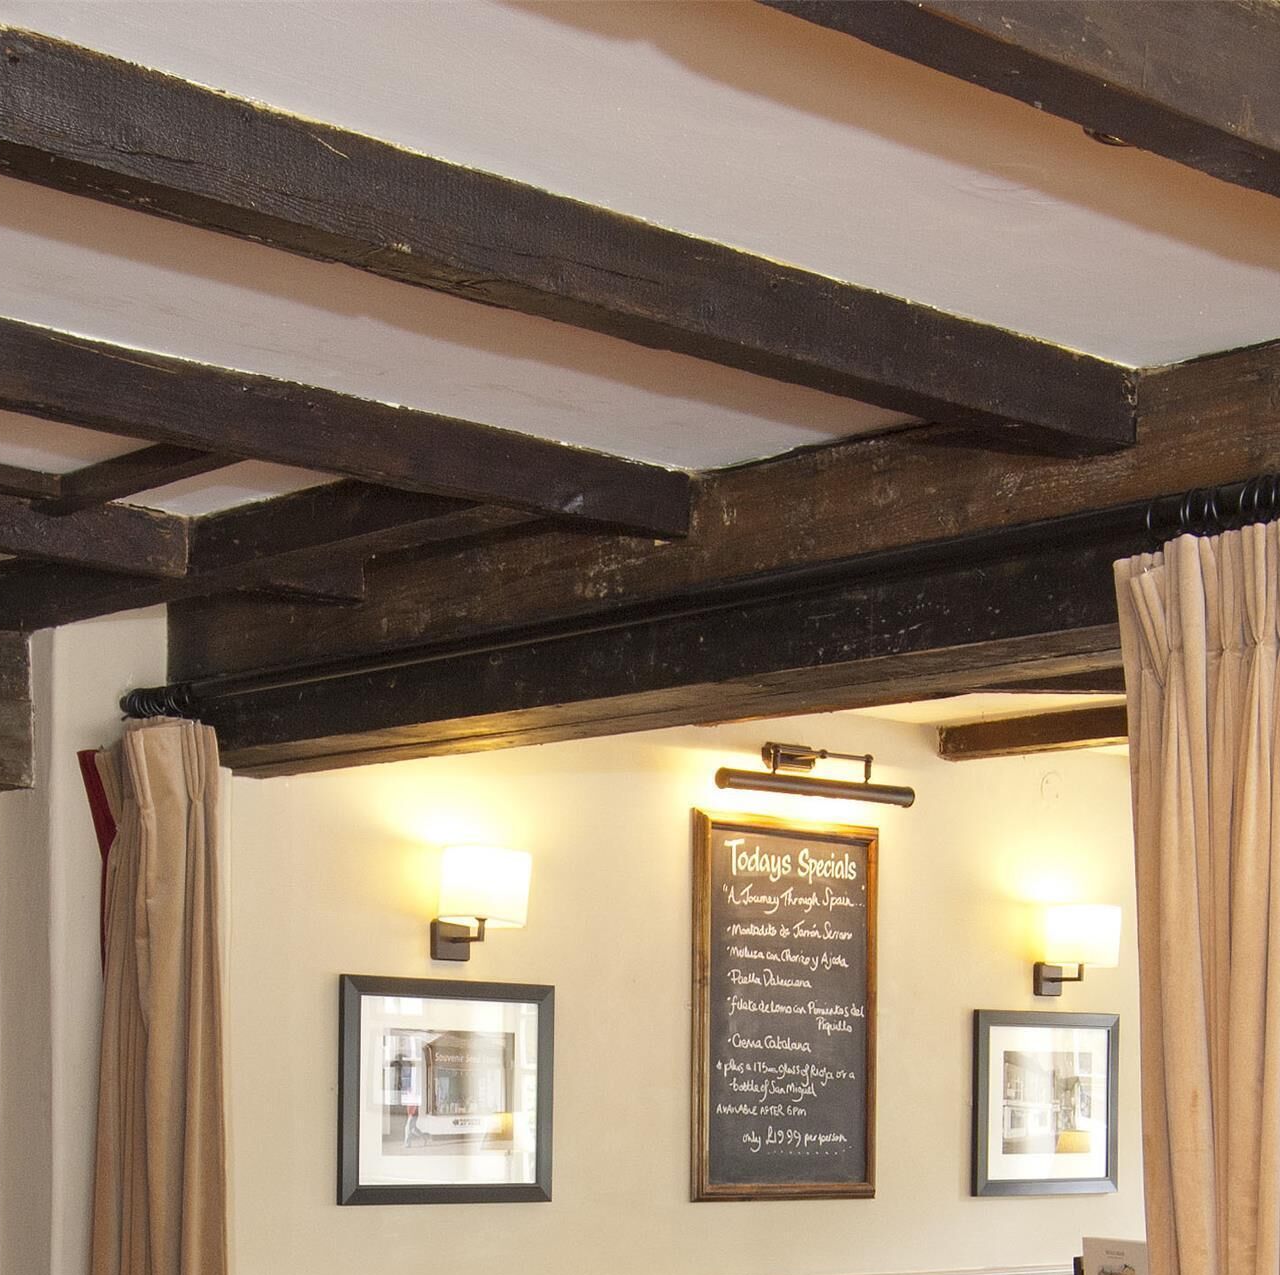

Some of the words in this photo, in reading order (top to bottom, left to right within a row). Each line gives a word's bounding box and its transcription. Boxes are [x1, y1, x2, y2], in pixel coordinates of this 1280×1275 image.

[724, 838, 791, 882] Todays
[797, 847, 857, 884] Specials
[740, 883, 780, 914] Journey
[780, 886, 820, 913] Through
[730, 969, 762, 985] Paella
[729, 1077, 760, 1093] bottle
[769, 1080, 786, 1094] San
[786, 1082, 817, 1102] Miguel
[716, 1103, 758, 1116] AVAILABLE
[760, 1103, 785, 1116] AFTER
